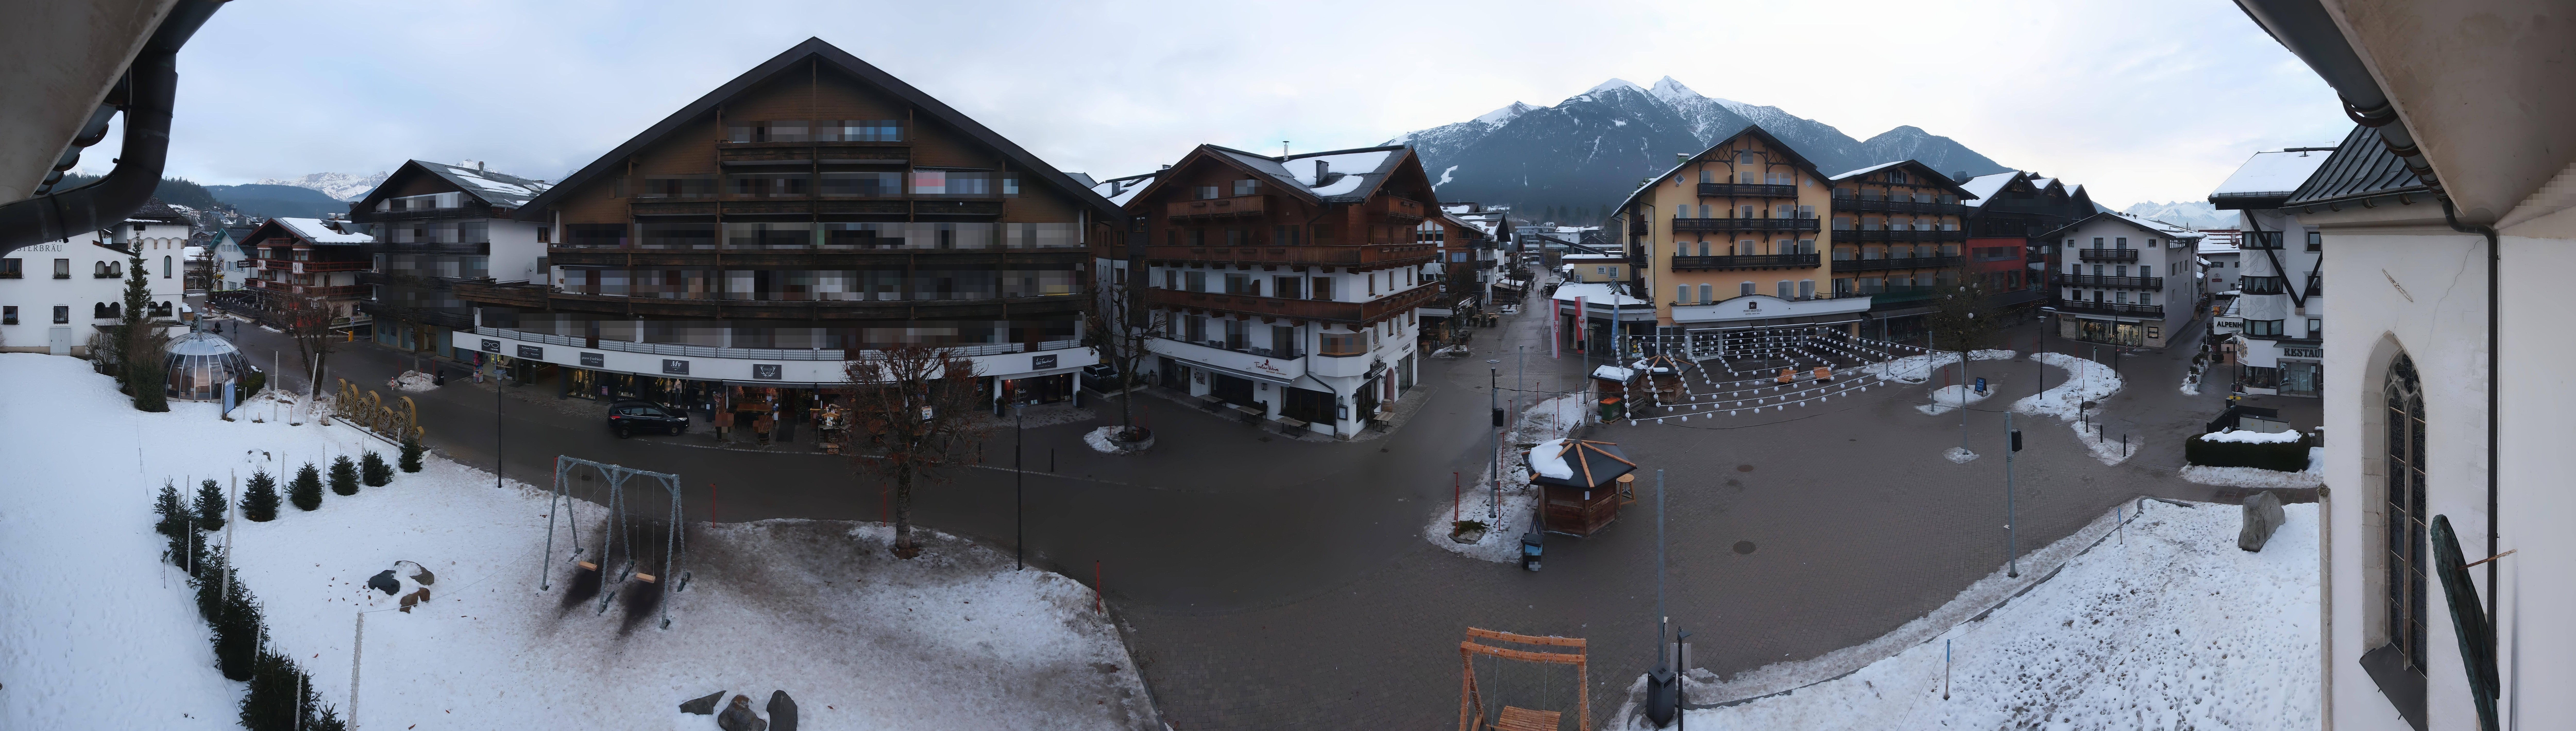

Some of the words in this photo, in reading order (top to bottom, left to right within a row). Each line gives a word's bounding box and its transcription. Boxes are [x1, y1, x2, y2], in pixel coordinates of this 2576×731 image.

[1402, 343, 1411, 352] SAILER
[671, 361, 682, 370] My
[1371, 364, 1386, 377] RESTAURANT
